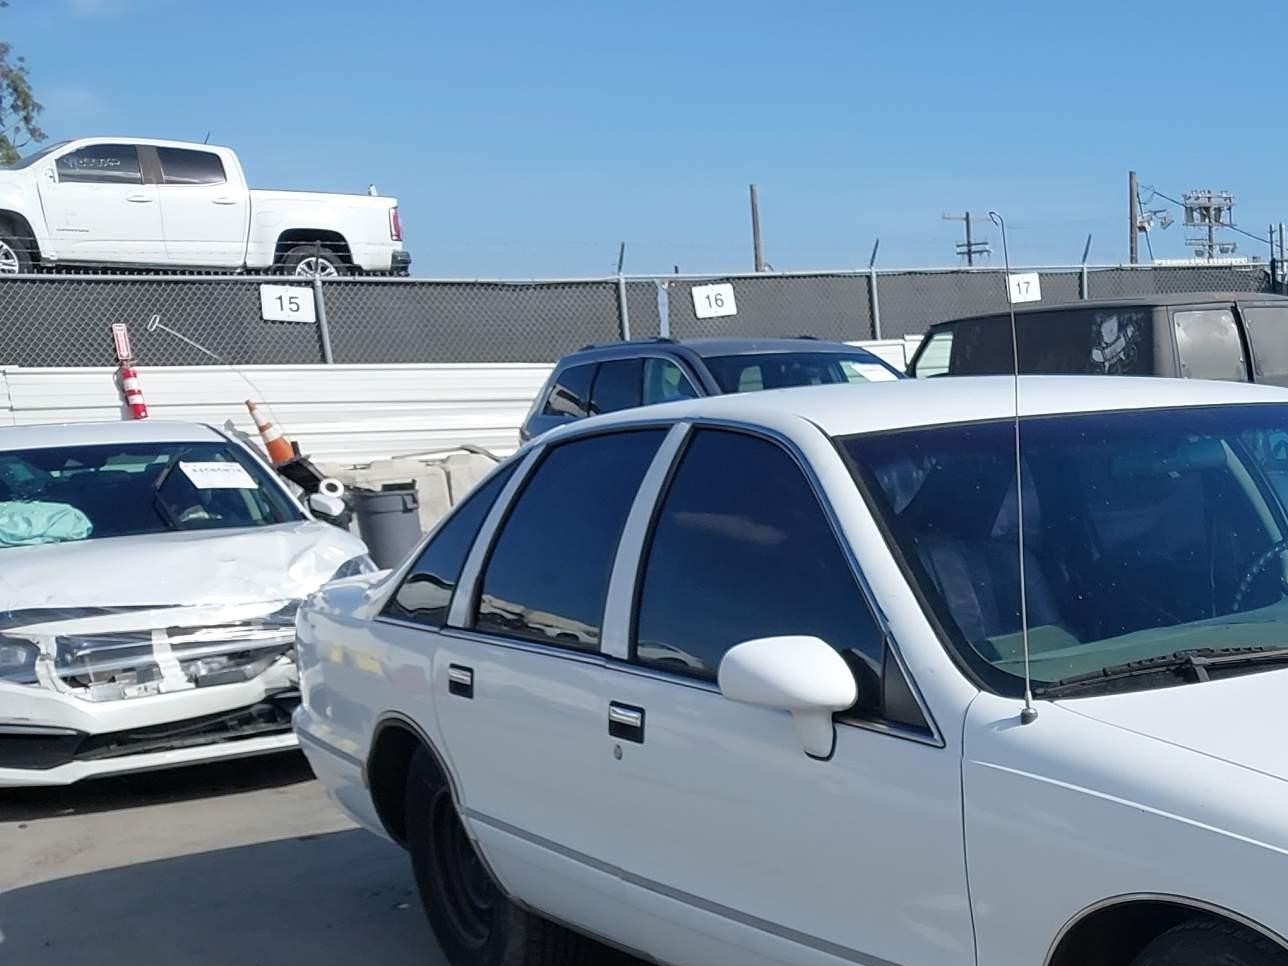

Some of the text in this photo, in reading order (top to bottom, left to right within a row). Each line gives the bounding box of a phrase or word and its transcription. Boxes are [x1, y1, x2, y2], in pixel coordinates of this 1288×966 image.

[1016, 281, 1031, 295] 17
[275, 295, 300, 312] 15
[705, 293, 724, 308] 16
